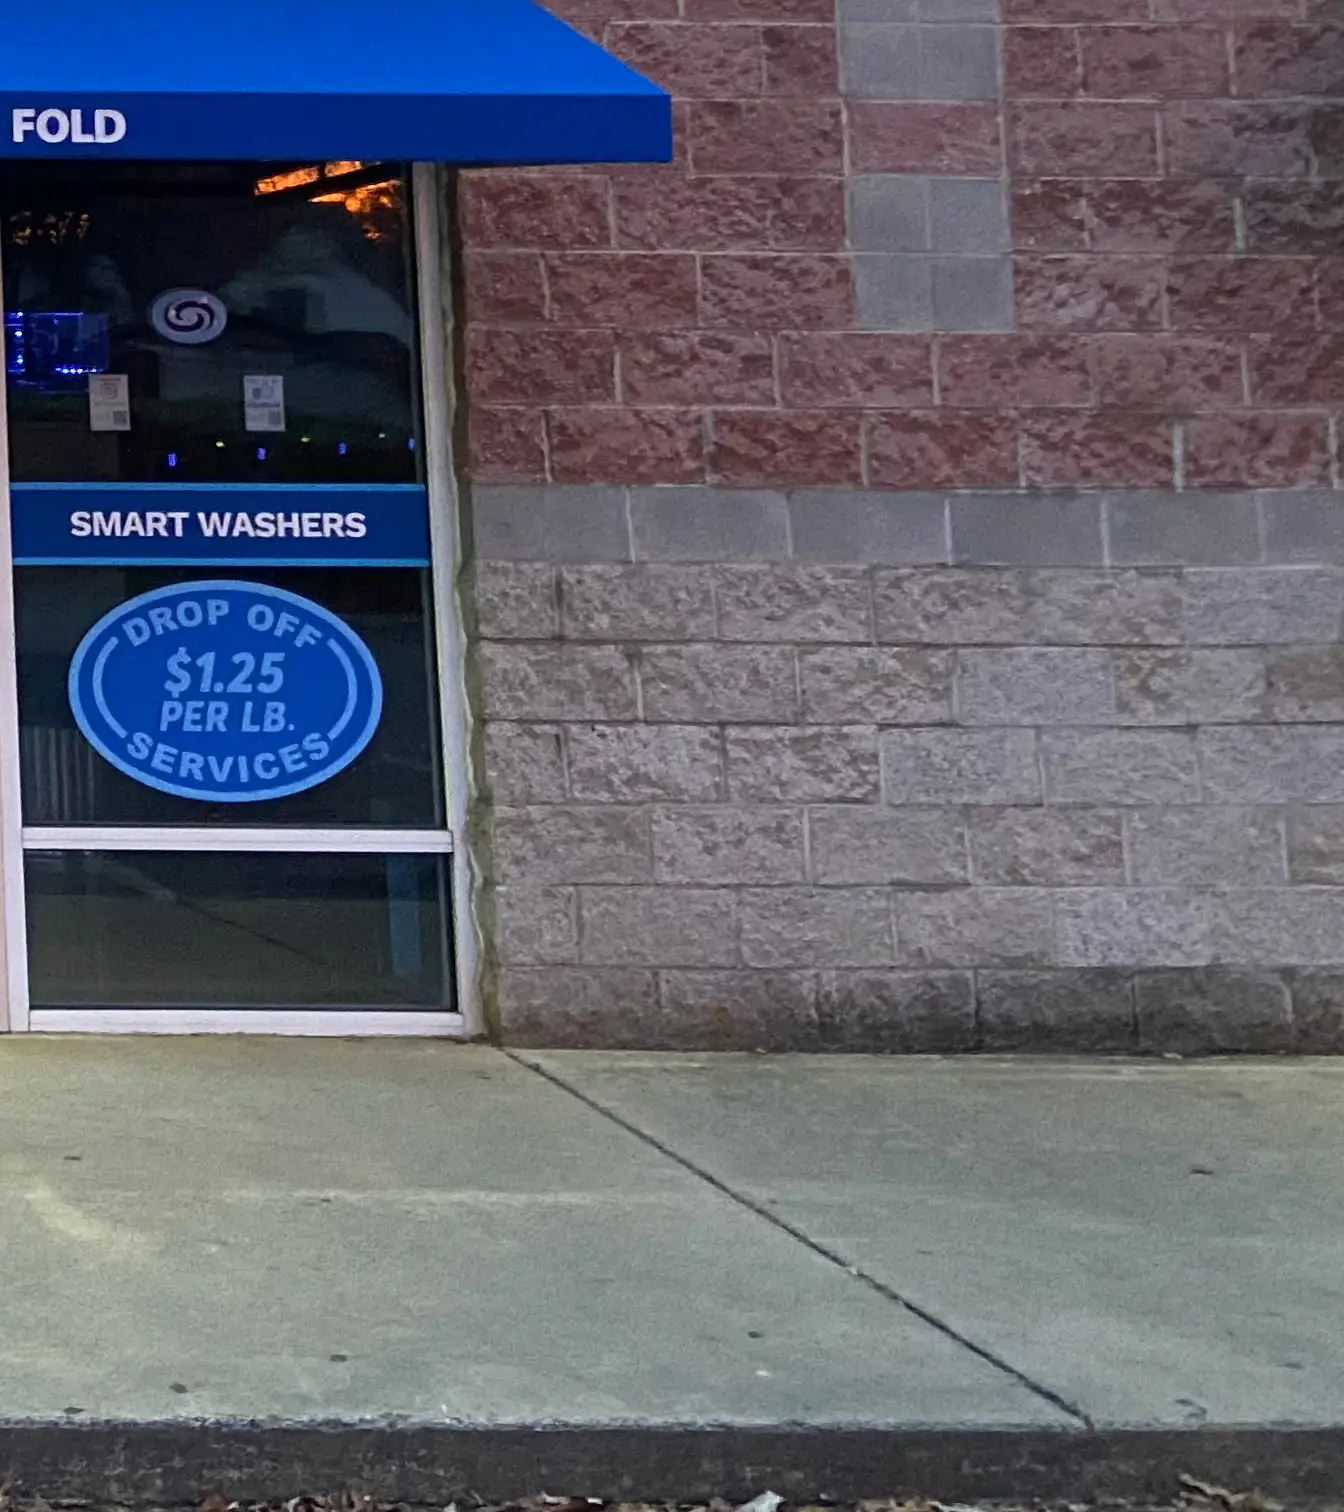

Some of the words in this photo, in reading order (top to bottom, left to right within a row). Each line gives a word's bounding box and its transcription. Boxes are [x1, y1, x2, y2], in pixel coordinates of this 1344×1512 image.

[12, 108, 127, 144] FOLD
[70, 511, 189, 537] SMART
[197, 511, 367, 538] WASHERS
[122, 599, 230, 647] DROP
[246, 604, 323, 648] OFF
[163, 646, 286, 699] $1.25
[159, 700, 229, 732] PER
[241, 700, 295, 733] LB.
[126, 731, 330, 783] SERVICES
